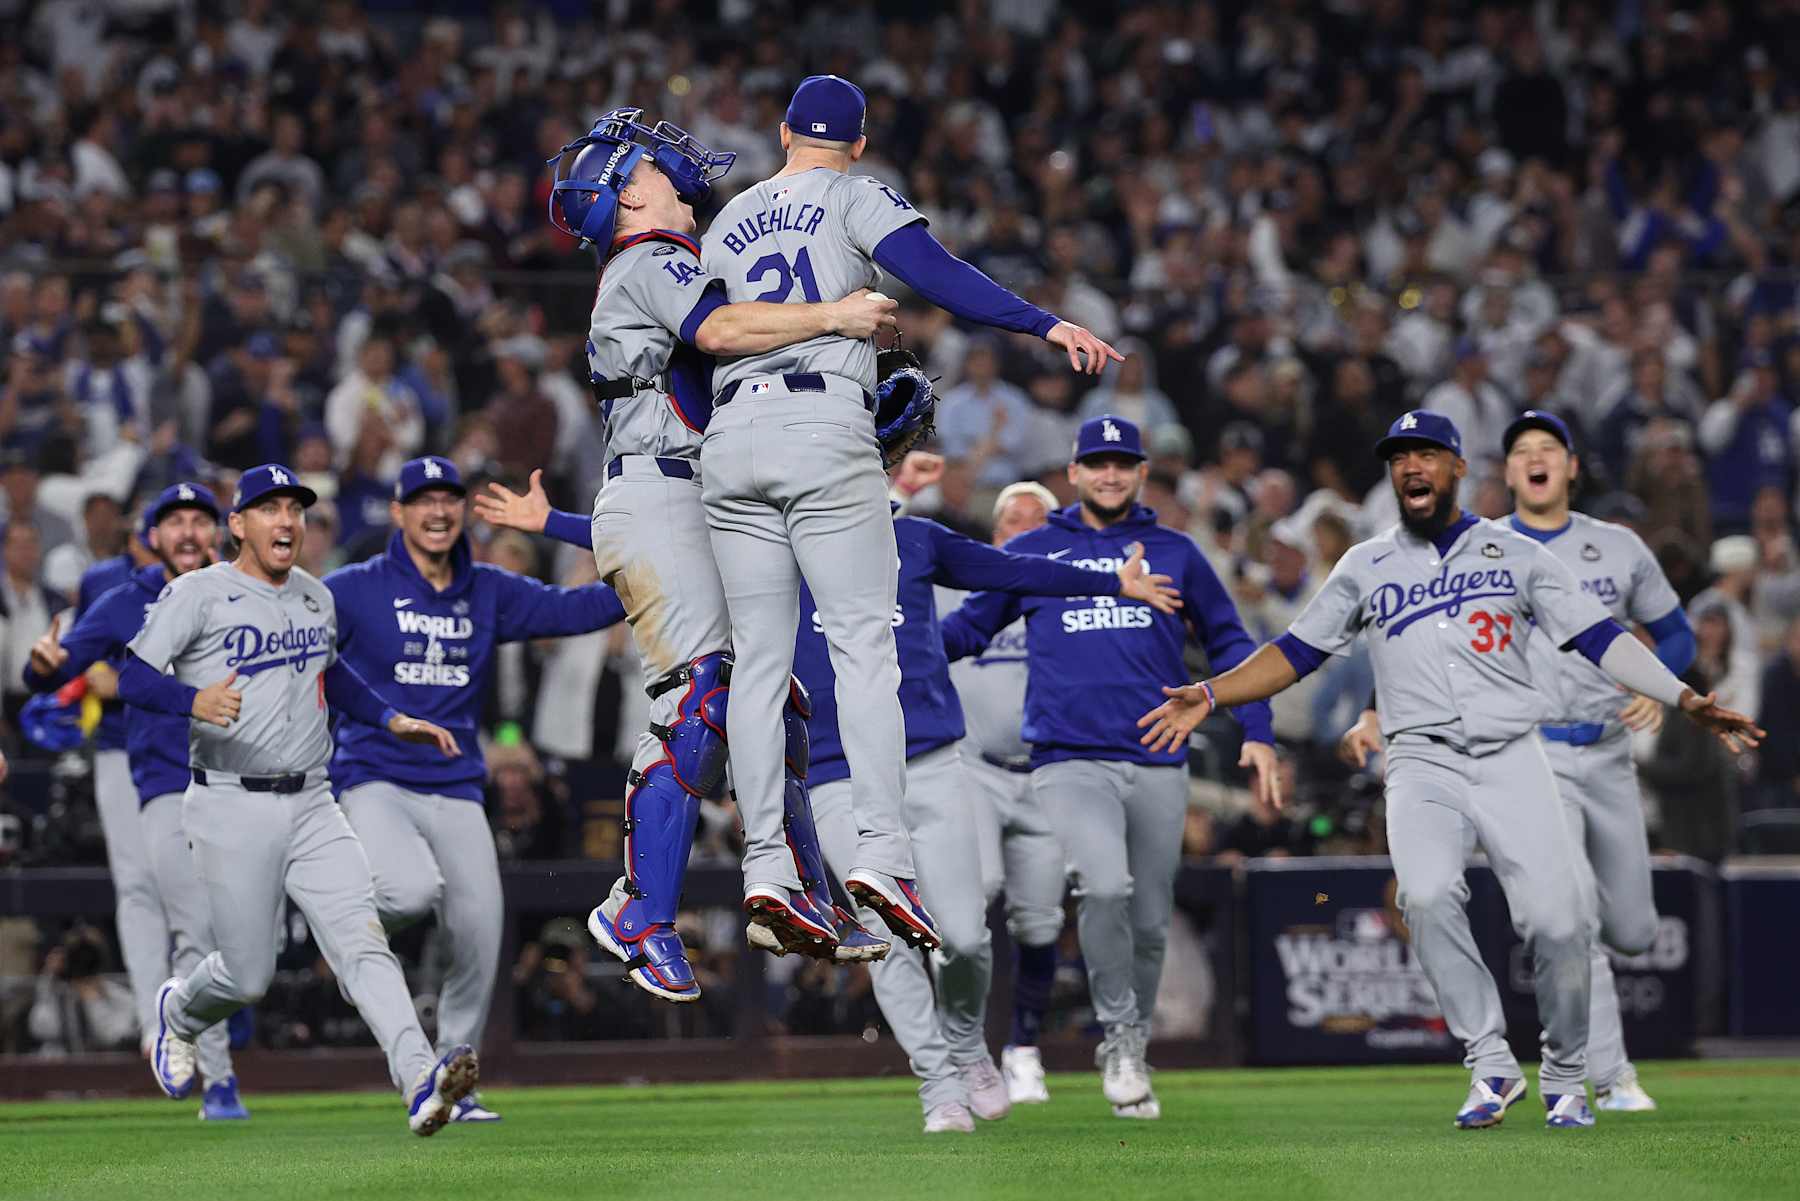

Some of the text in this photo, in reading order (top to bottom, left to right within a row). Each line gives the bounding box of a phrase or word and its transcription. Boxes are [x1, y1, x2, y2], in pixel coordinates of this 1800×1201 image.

[598, 150, 621, 186] TRAUSS
[723, 203, 825, 255] BUEHLER
[662, 260, 706, 286] LA
[746, 246, 822, 303] 21
[268, 465, 292, 486] LA
[1061, 606, 1153, 633] SERIES
[1370, 565, 1517, 640] Dodgers
[396, 609, 473, 640] WORLD
[1468, 610, 1513, 653] 37
[223, 619, 328, 677] Dodger
[394, 661, 470, 688] SERIES
[1275, 932, 1424, 980] WORL
